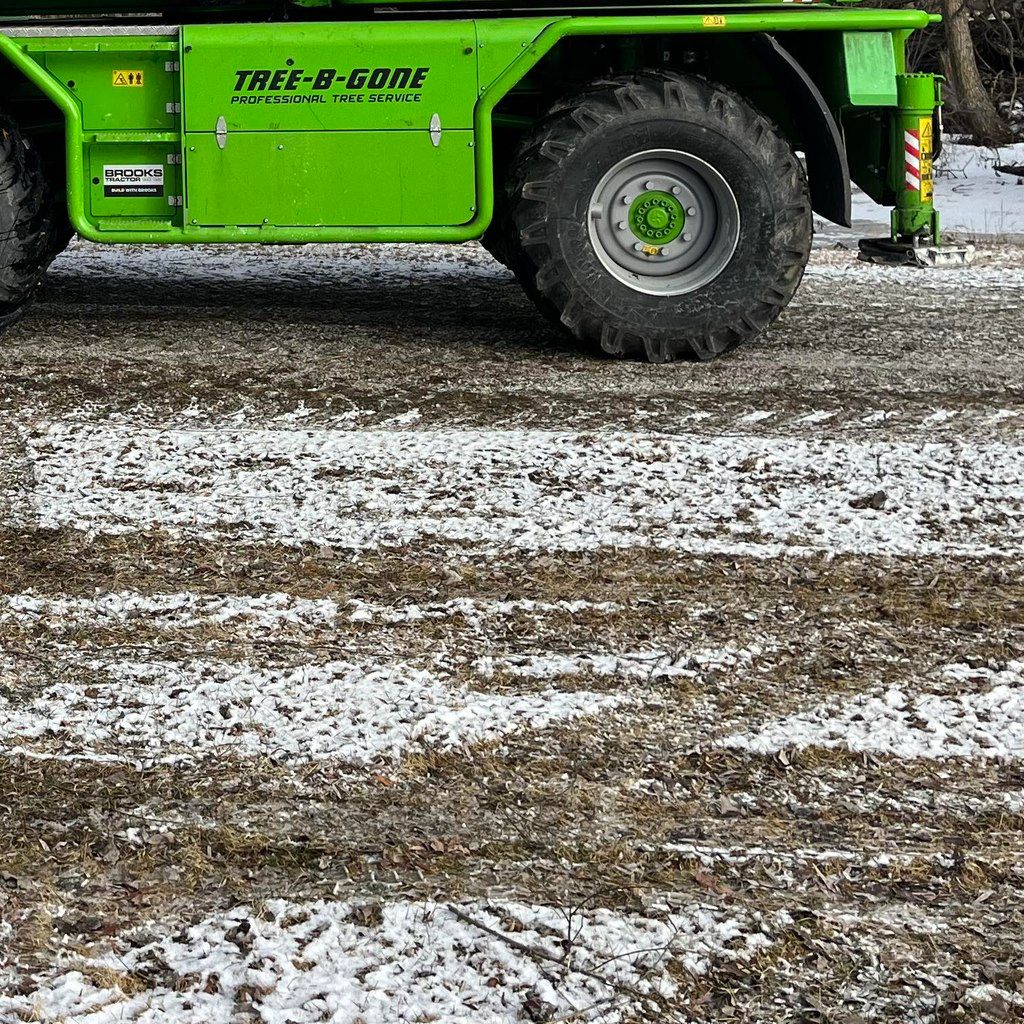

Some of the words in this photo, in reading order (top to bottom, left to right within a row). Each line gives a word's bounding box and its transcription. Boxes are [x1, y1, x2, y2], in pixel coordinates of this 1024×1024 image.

[234, 68, 430, 92] TREE-B-GONE
[231, 94, 326, 104] PROFESSIONAL
[332, 94, 364, 103] TREE
[369, 93, 422, 103] SERVICE
[105, 169, 163, 177] BROOKS
